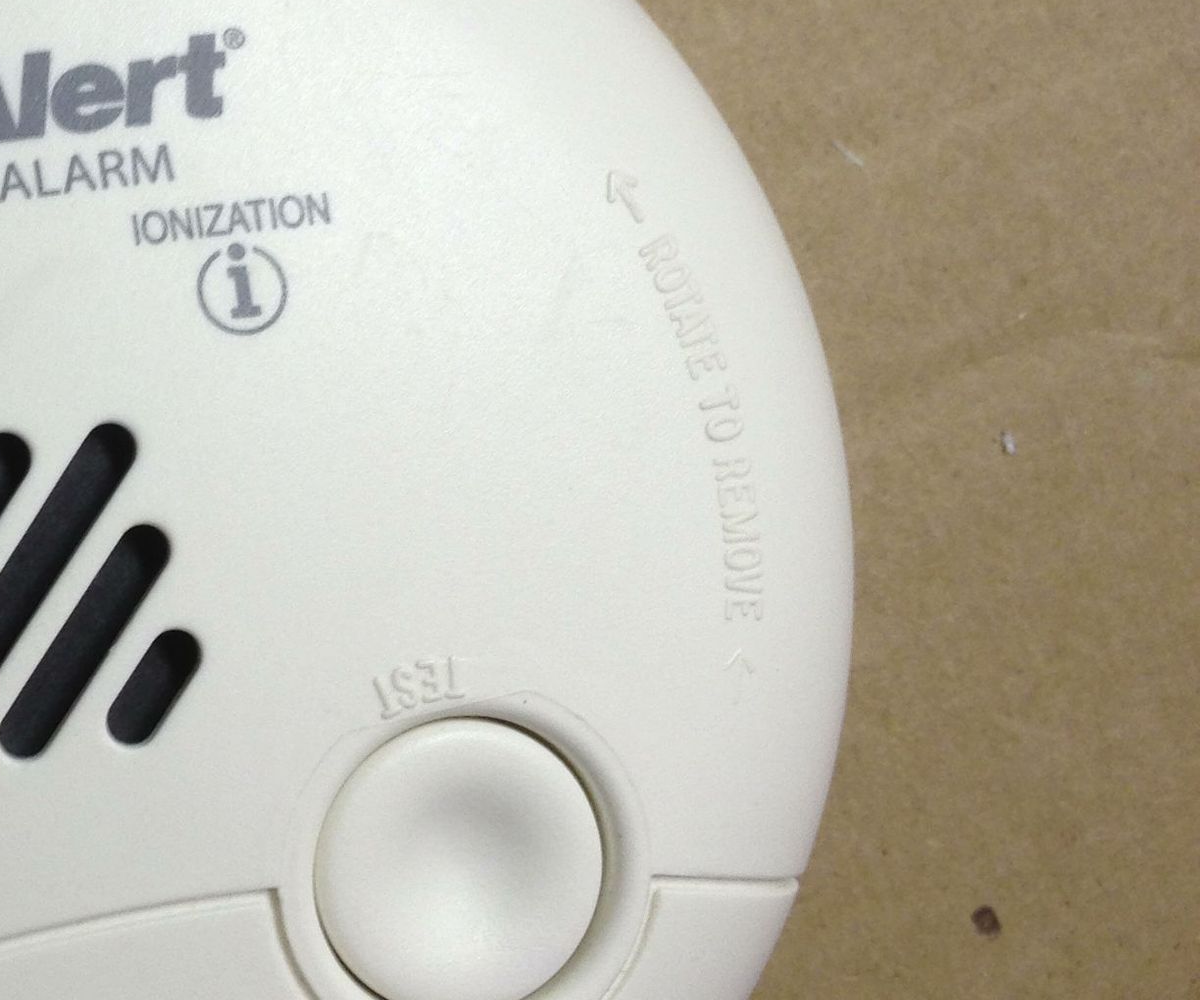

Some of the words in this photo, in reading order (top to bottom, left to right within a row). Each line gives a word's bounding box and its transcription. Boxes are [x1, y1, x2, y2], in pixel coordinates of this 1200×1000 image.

[131, 191, 332, 247] IONIZATION
[638, 232, 728, 383] ROTATE
[699, 386, 745, 443] TO
[711, 453, 765, 623] REMOVE
[371, 654, 466, 721] TEST
